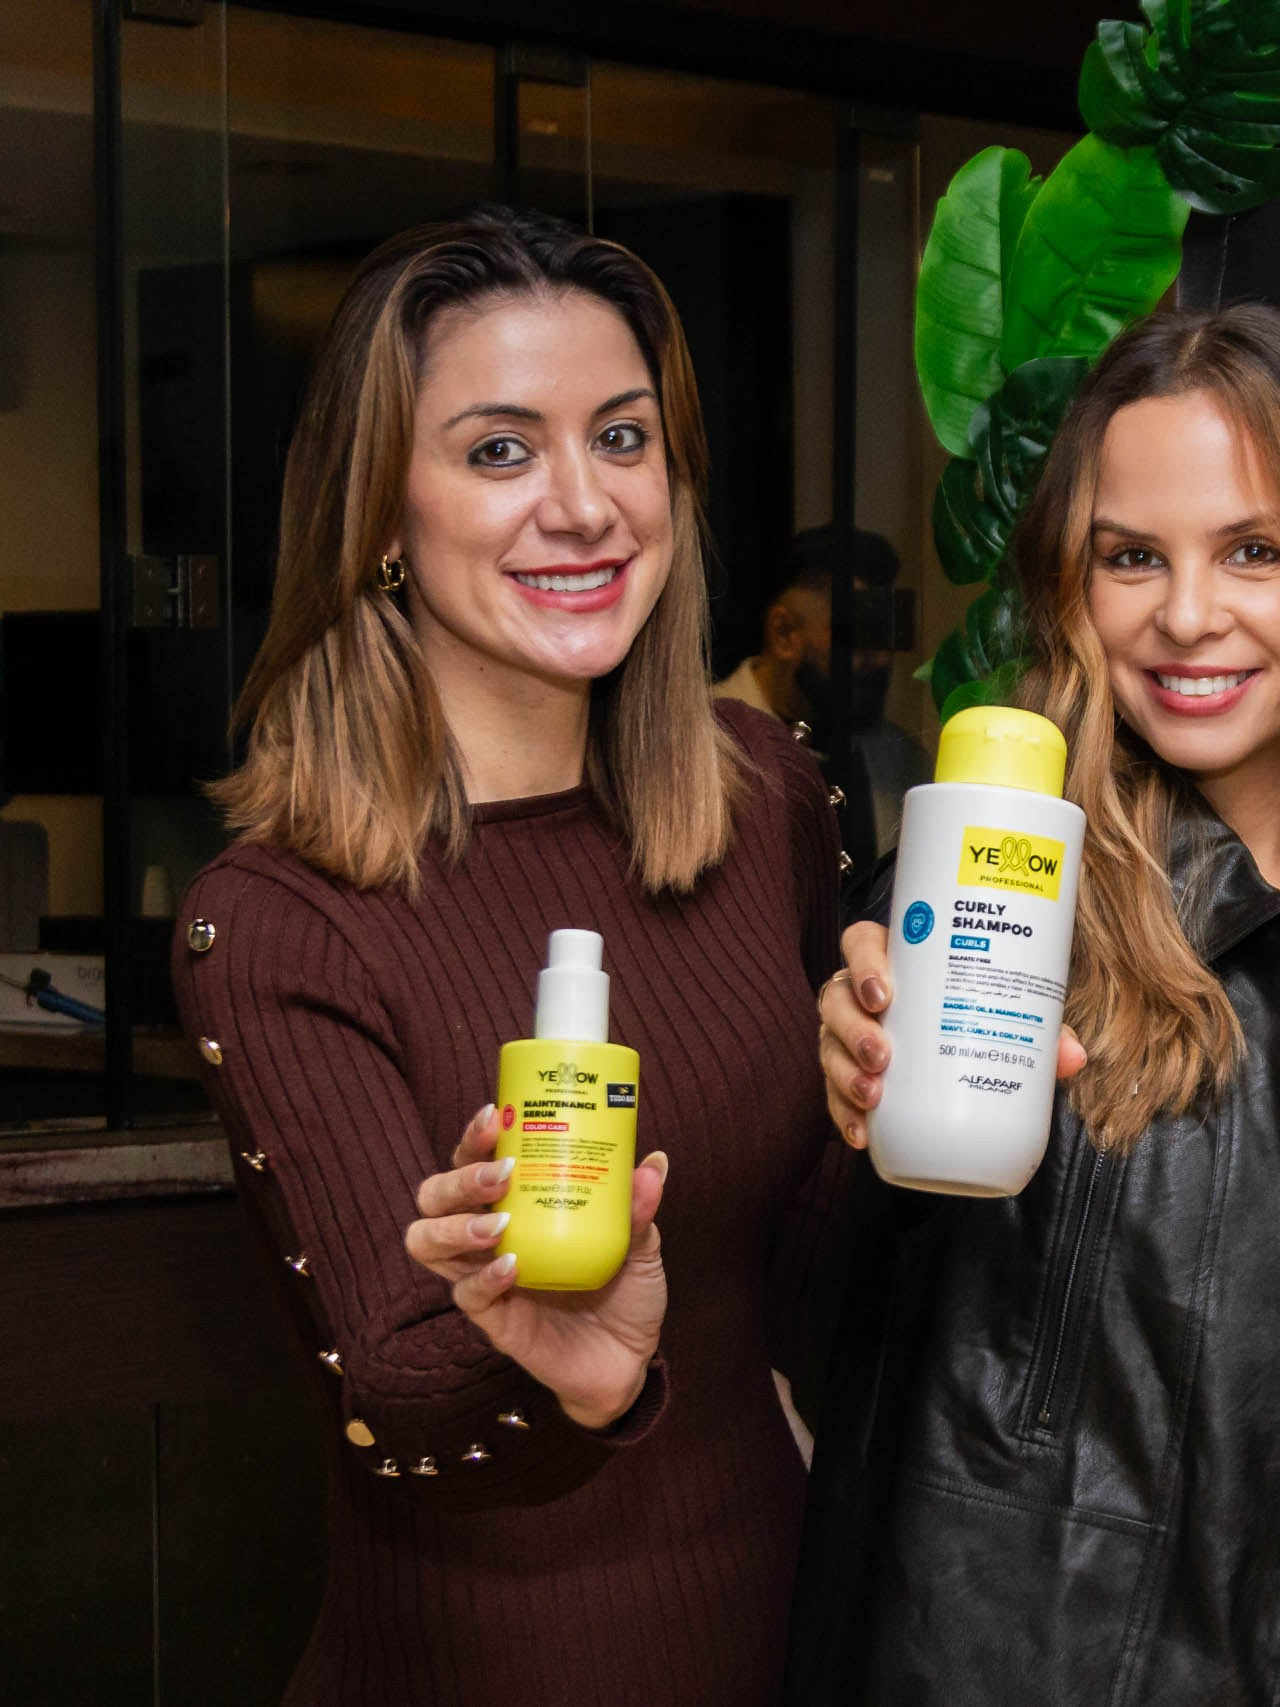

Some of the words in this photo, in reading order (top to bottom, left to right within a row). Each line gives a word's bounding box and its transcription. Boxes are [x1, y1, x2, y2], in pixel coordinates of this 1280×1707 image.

[969, 836, 1058, 877] YELLOW
[980, 875, 1044, 892] PROFESSIONAL
[954, 900, 1007, 916] CURLY
[952, 916, 1033, 938] SHAMPOO
[954, 938, 987, 949] CURLS
[939, 1044, 957, 1056] 500
[958, 1074, 1023, 1091] ALFAPARF
[969, 1084, 1012, 1095] MILANO
[523, 1100, 597, 1110] MAINTENANCE
[523, 1110, 556, 1118] SERUM
[535, 1198, 588, 1206] ALFAPARF
